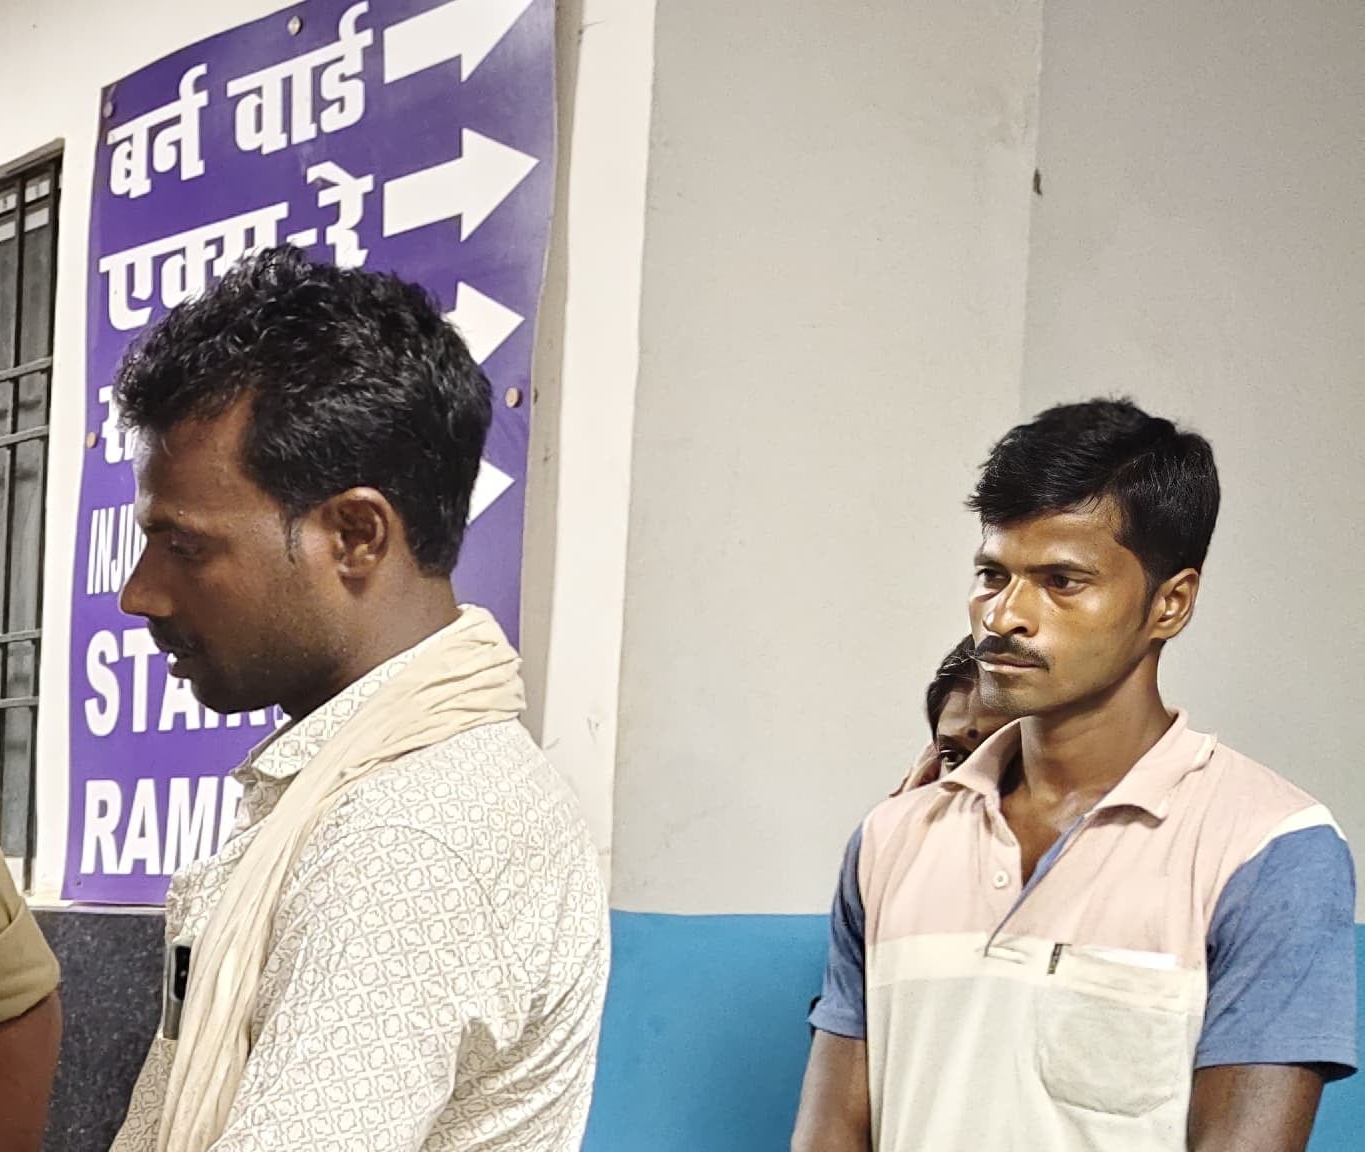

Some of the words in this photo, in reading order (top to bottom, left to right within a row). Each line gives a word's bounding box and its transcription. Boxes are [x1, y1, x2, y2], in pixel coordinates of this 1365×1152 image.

[107, 63, 209, 199] बर्न
[226, 1, 373, 155] वार्ड
[86, 503, 148, 595] INJU
[84, 627, 293, 737] STA
